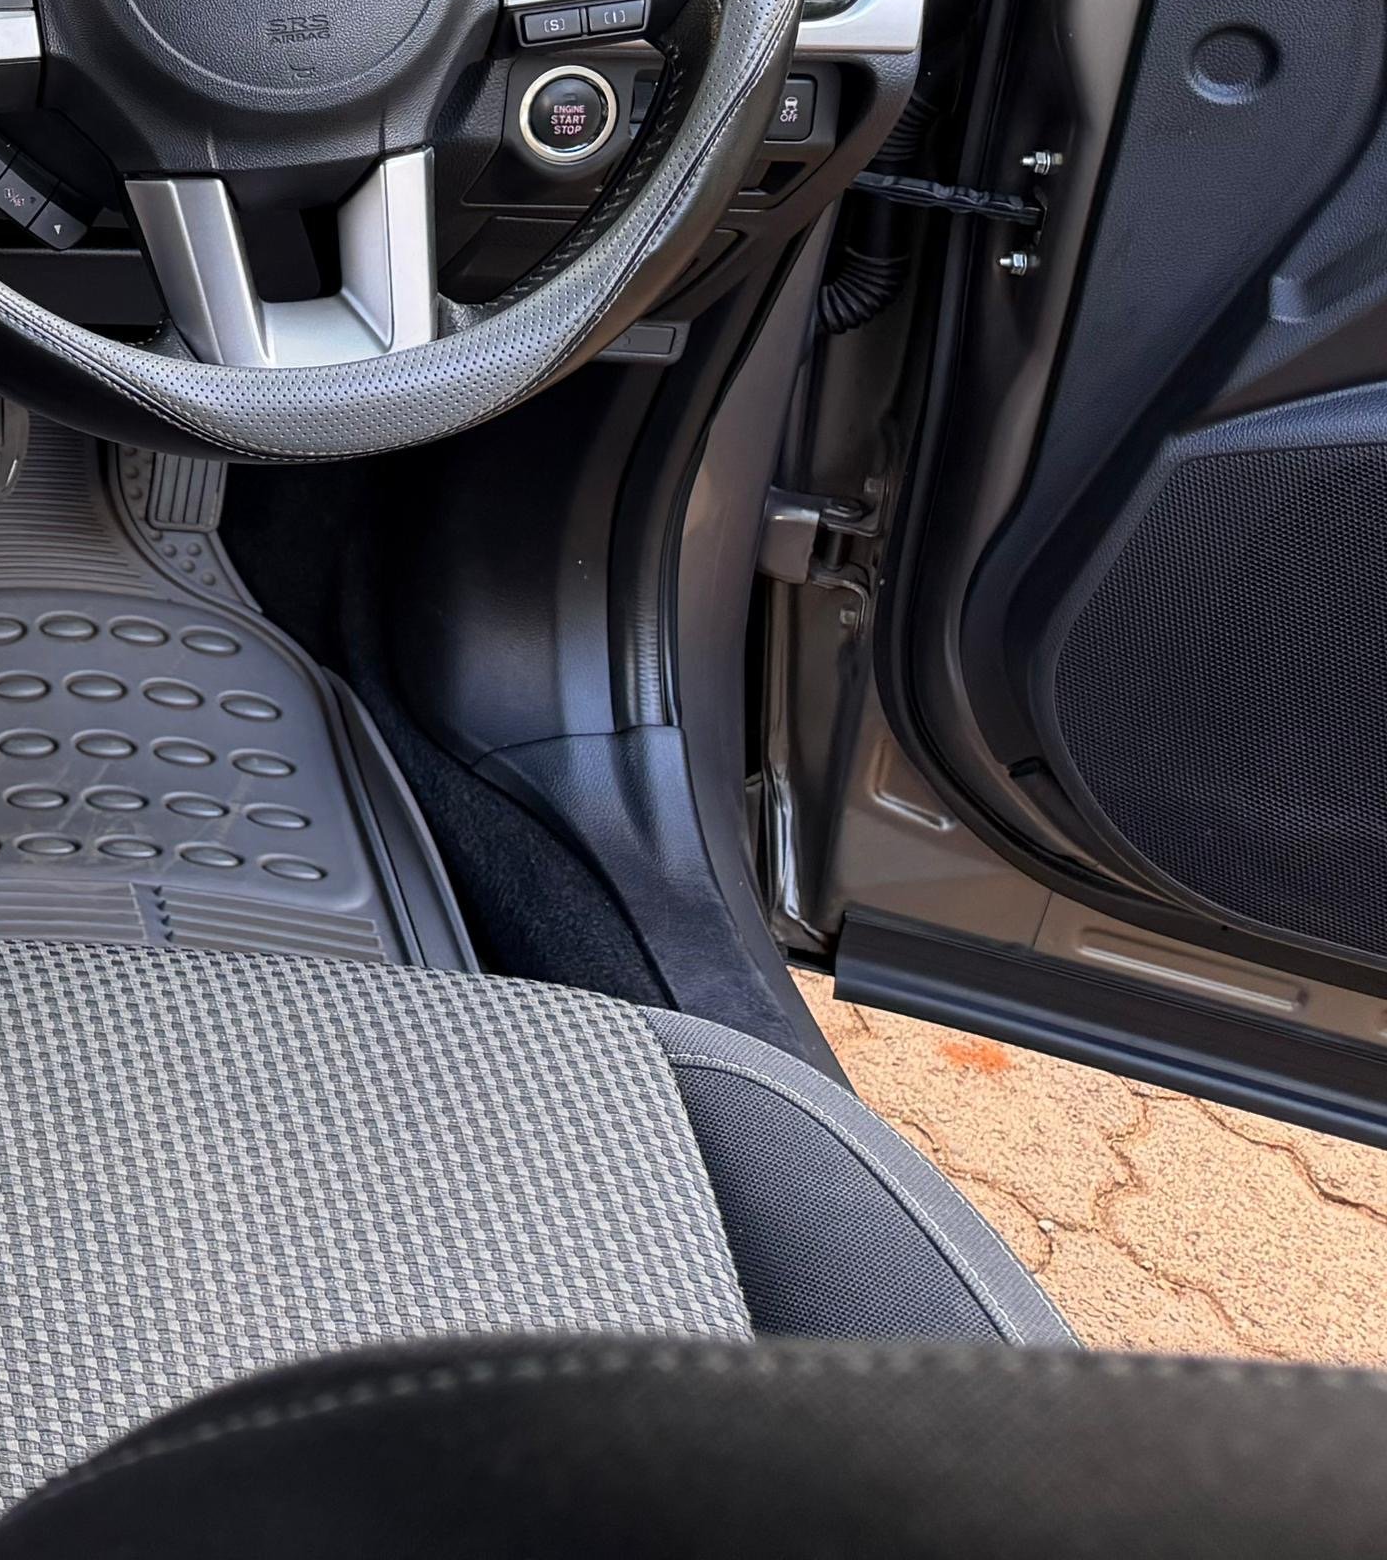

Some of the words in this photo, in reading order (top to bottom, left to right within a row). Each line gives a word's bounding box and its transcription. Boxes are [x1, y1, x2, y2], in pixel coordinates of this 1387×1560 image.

[553, 105, 585, 114] ENGINE
[550, 114, 587, 125] START
[780, 113, 798, 123] OFF
[554, 125, 582, 135] STOP
